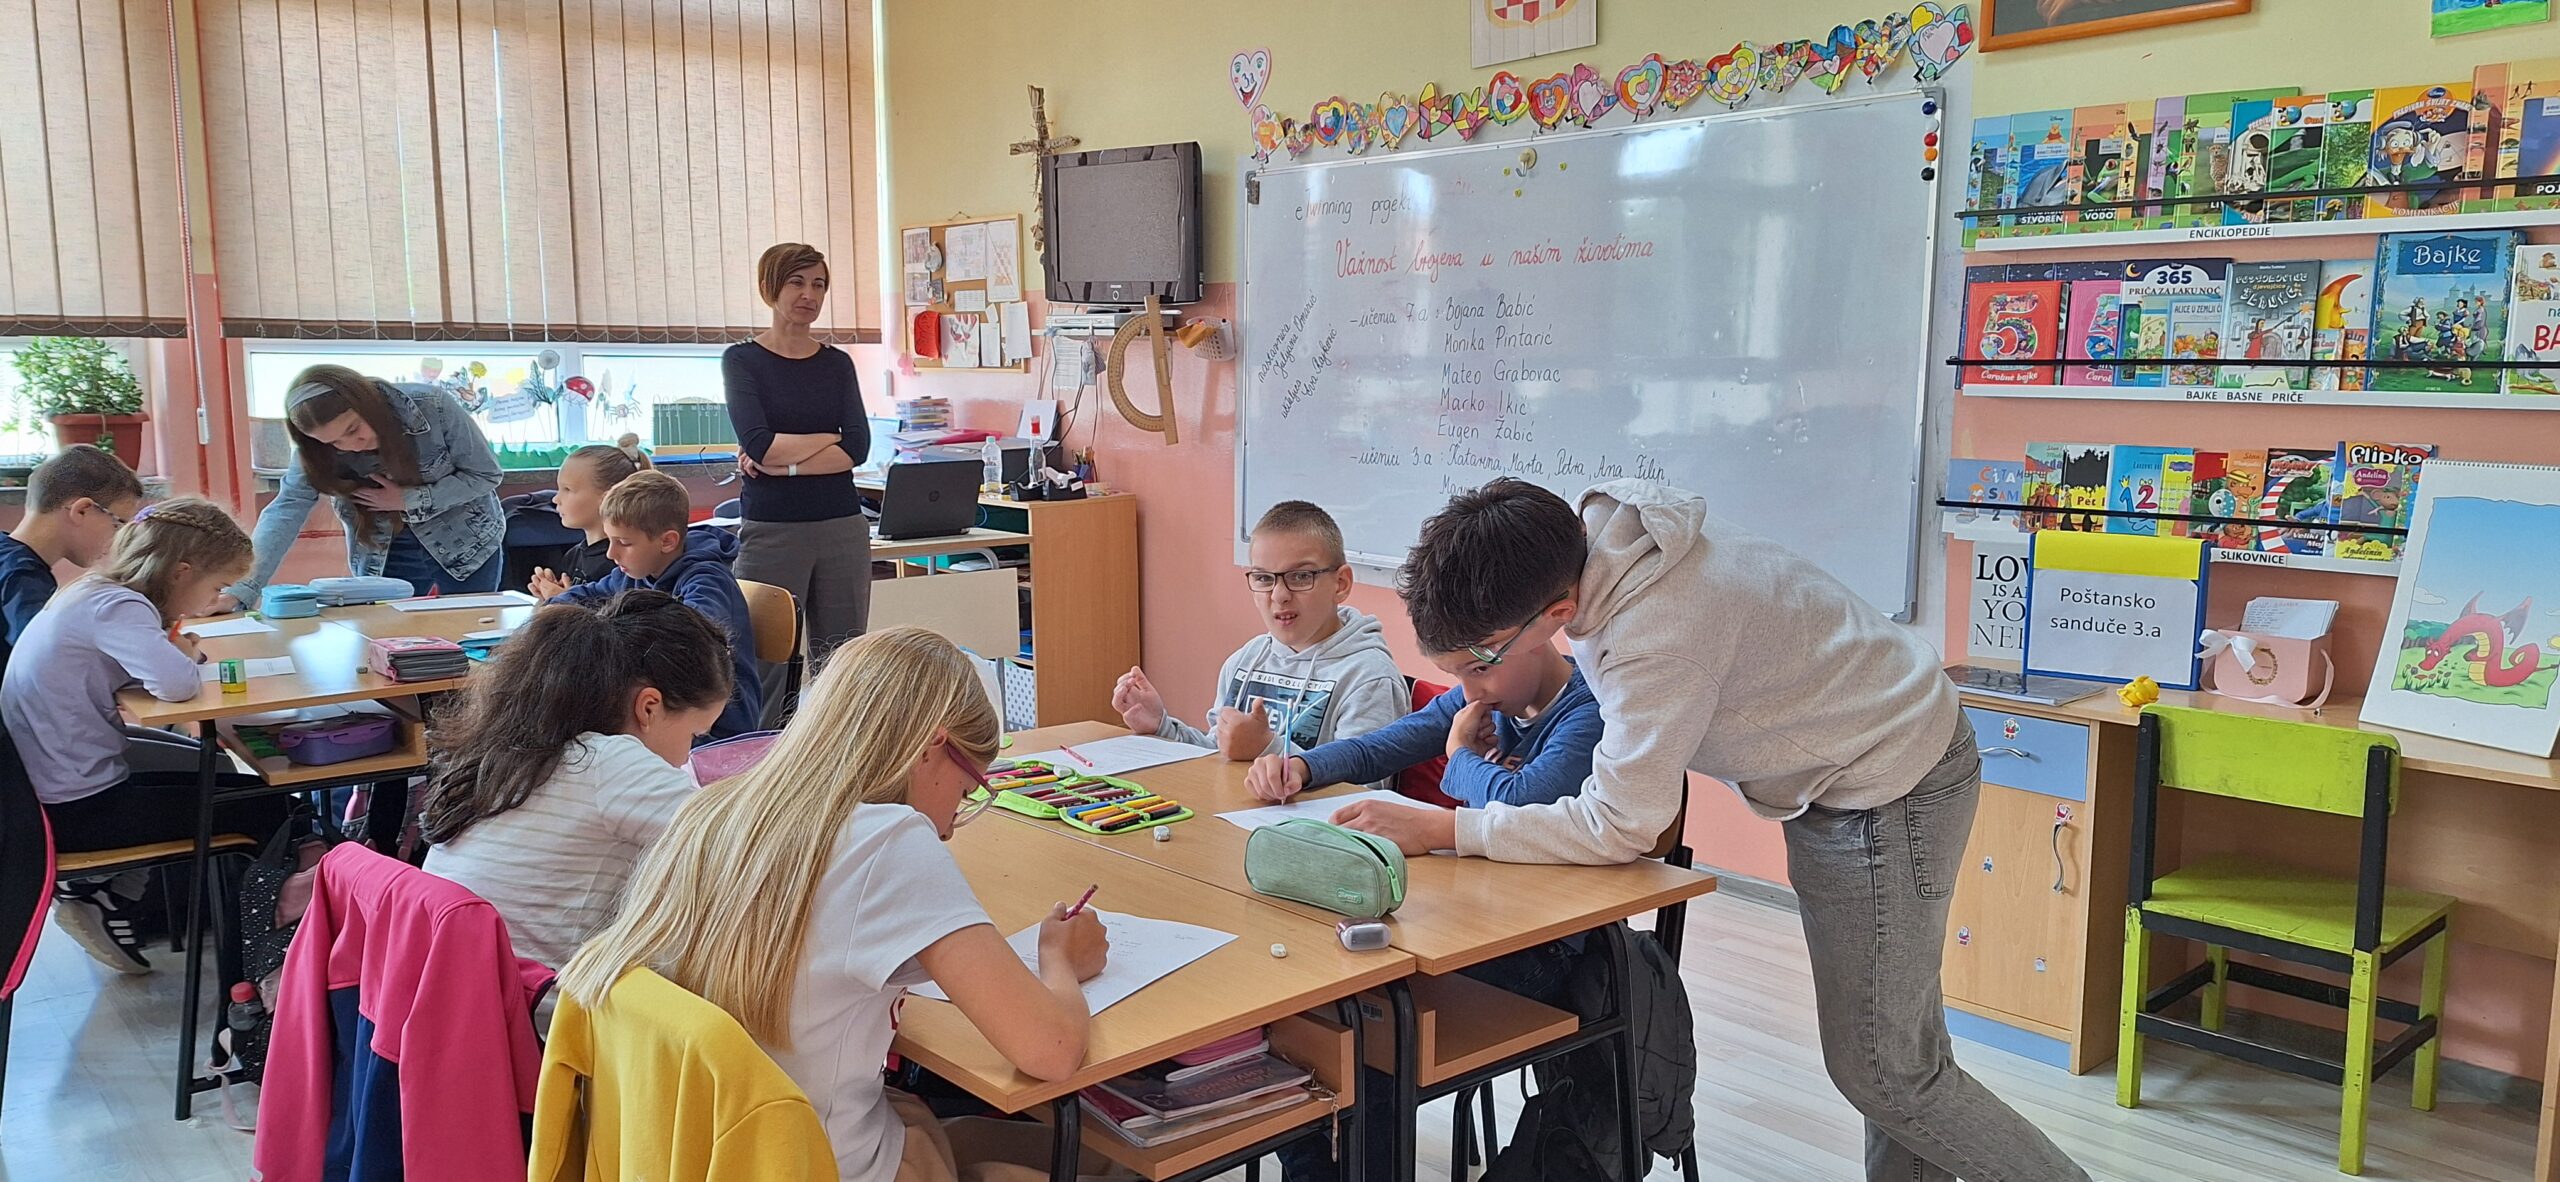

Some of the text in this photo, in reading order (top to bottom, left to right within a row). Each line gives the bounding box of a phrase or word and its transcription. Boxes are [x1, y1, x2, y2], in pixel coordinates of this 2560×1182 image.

[2189, 227, 2271, 239] ENCIKLOPEDIJE
[1336, 233, 1654, 283] Važnost brojeva u našim životima
[2412, 244, 2481, 268] Bajke
[2157, 271, 2192, 285] 365
[2129, 286, 2156, 295] PRIČA
[2158, 287, 2171, 295] ZA
[1445, 297, 1485, 331] Bojana
[1496, 292, 1536, 319] Babić
[1444, 323, 1553, 353] Monika Pintarić
[1441, 358, 1561, 385] Mateo Grabovac
[1440, 388, 1528, 416] Marko Ikić
[2186, 390, 2304, 402] BAJKE BASNE PRIČE
[1437, 414, 1535, 444] Eugen Žabić
[1989, 487, 2018, 502] SAM
[2220, 550, 2285, 564] SLIKOVNICE
[1991, 584, 2007, 597] IS
[2060, 587, 2156, 610] Poštansko
[2050, 614, 2161, 638] sanduče 3.a
